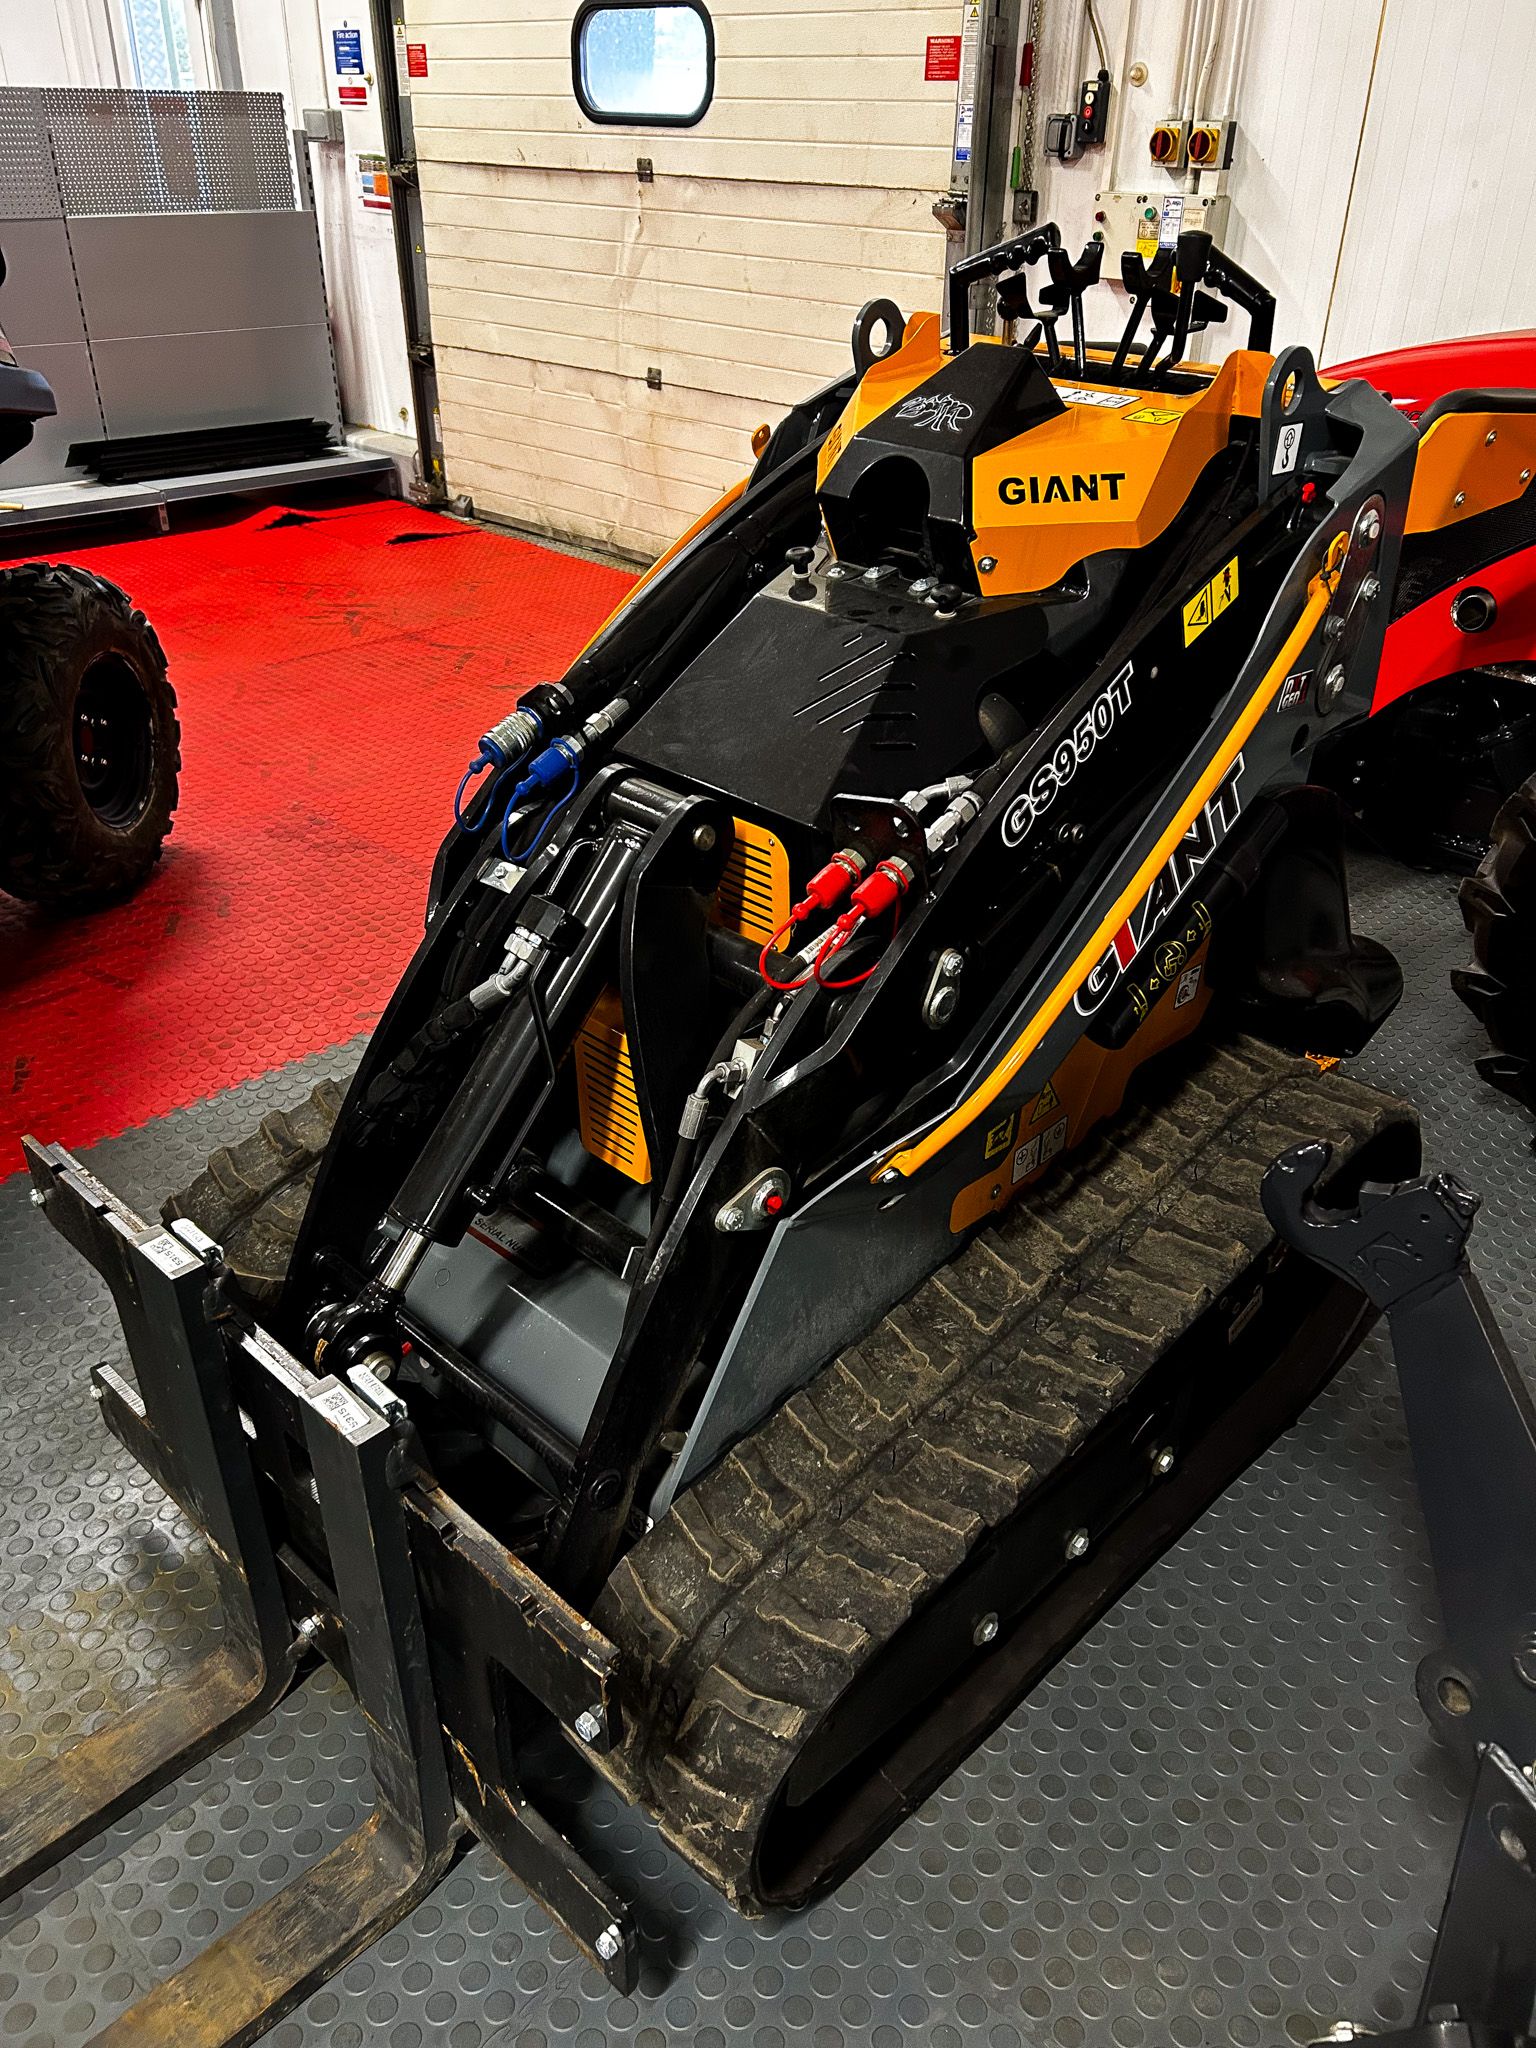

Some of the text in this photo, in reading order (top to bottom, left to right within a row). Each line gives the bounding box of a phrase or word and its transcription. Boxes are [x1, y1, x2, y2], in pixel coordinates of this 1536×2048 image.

[336, 31, 358, 39] Fire action
[998, 472, 1126, 506] GIANT
[1001, 659, 1134, 848] GS950T
[1073, 752, 1246, 1017] GIANT
[474, 1217, 507, 1243] SERIAL
[164, 1250, 184, 1266] 5315
[337, 1407, 359, 1429] 5315
